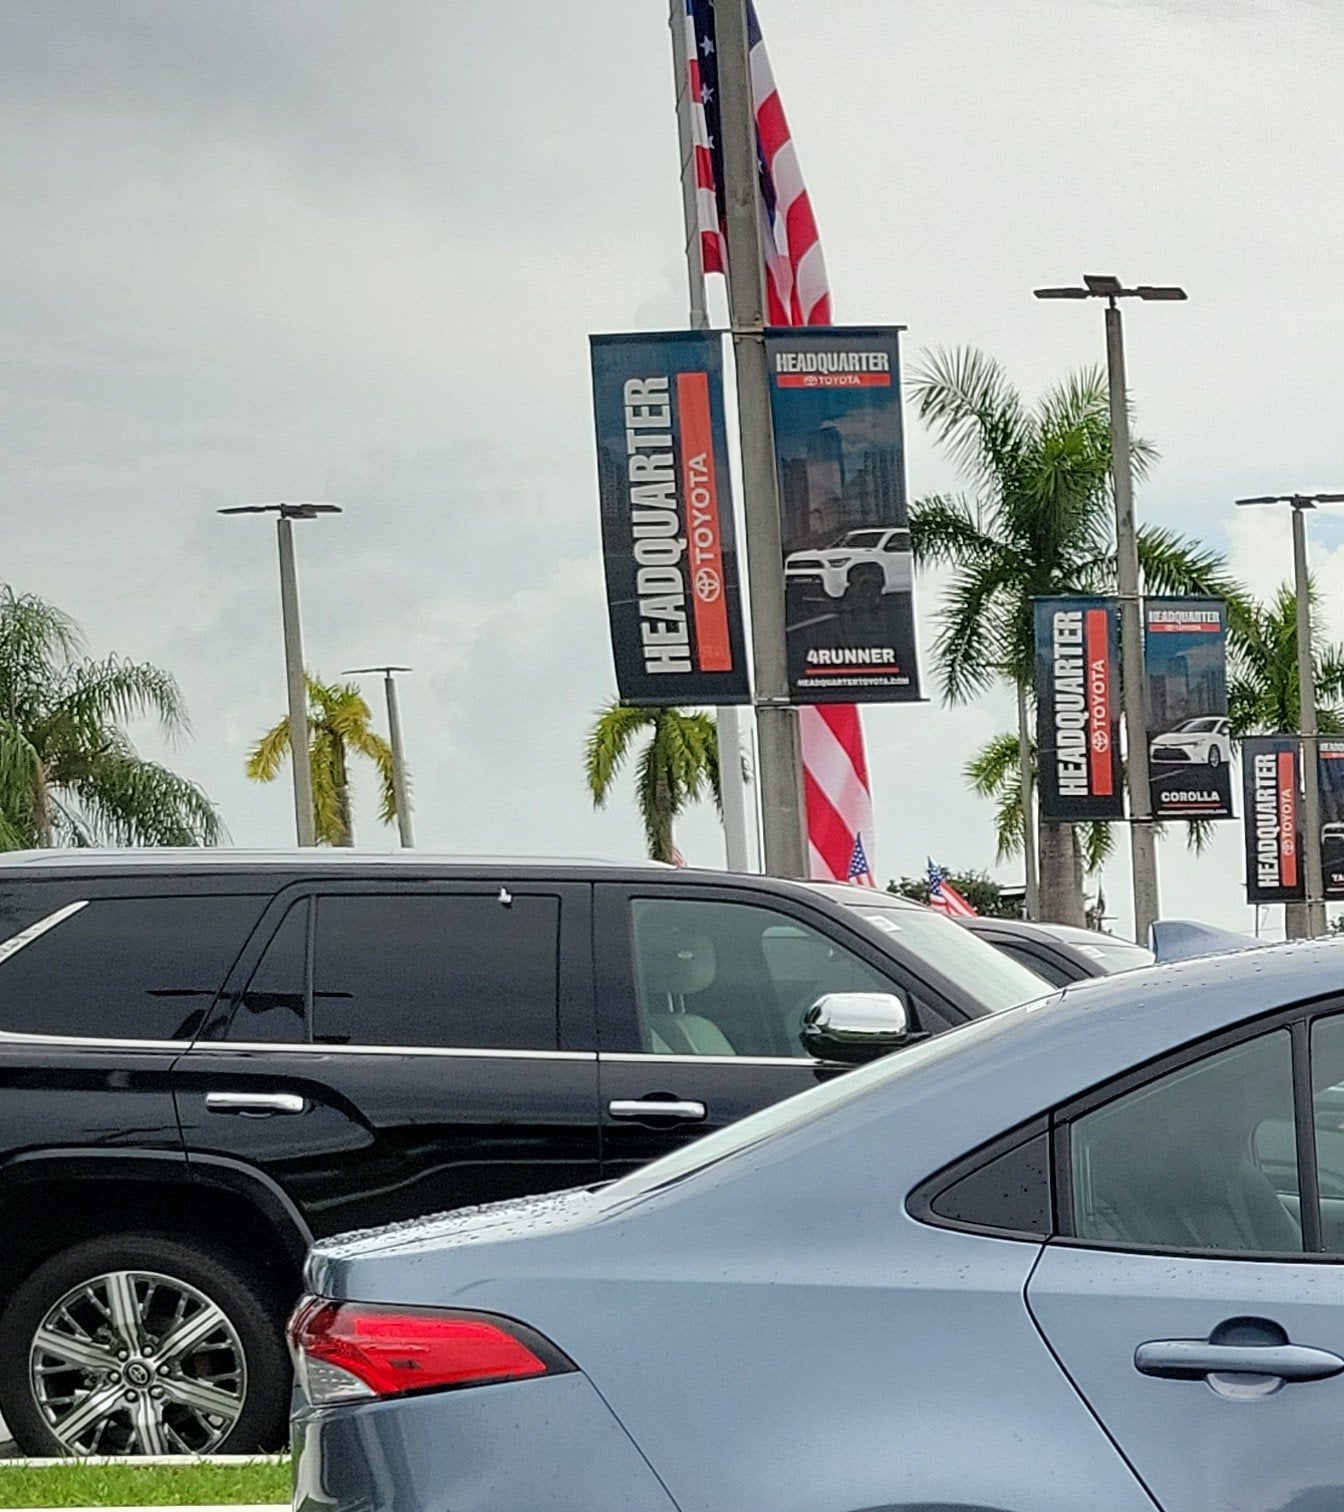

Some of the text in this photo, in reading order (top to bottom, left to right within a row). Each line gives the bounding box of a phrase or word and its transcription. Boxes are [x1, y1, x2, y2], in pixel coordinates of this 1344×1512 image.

[776, 352, 889, 374] HEADQUARTER
[819, 375, 861, 385] TOYOTA
[624, 376, 692, 674] HEADQUARTER
[687, 452, 714, 565] TOYOTA
[807, 648, 895, 664] 4RUNNER
[1053, 610, 1089, 795] HEADQUARTER
[1092, 659, 1107, 729] TOYOTA
[1161, 791, 1220, 802] COROLLA
[1255, 754, 1280, 887] HEADQUARTER
[1282, 788, 1293, 840] TOYOTA
